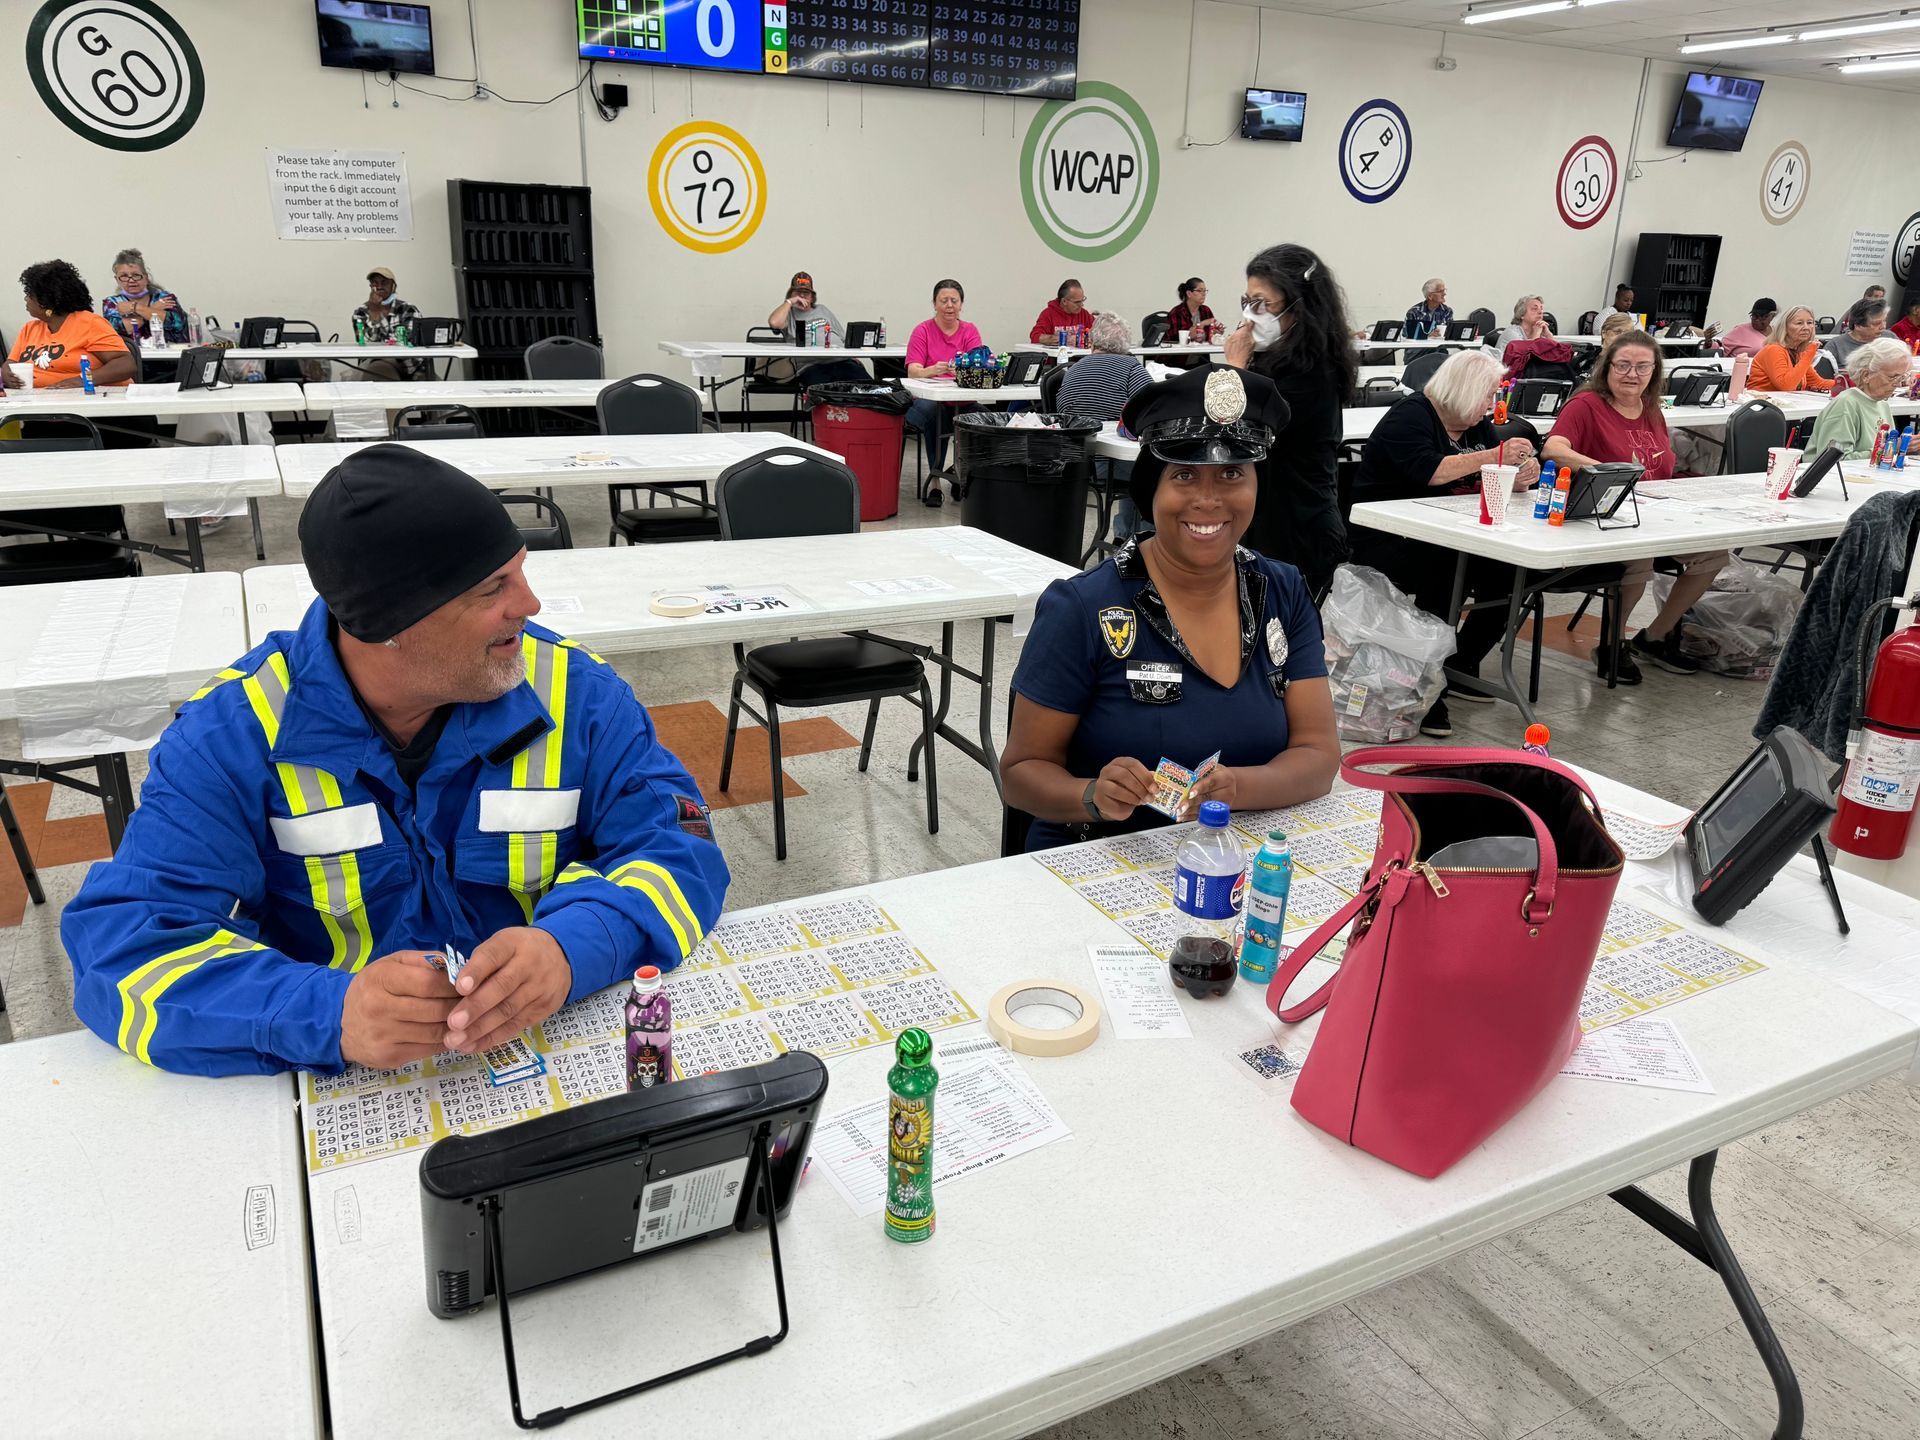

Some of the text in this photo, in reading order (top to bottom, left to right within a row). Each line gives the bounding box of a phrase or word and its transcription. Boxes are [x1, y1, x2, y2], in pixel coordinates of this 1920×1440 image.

[1064, 1, 1077, 13] 15
[872, 1, 887, 12] 20
[892, 3, 907, 14] 21
[912, 5, 926, 16] 22
[935, 7, 949, 19] 23
[954, 9, 968, 21] 24
[973, 11, 987, 23] 25
[992, 13, 1005, 25] 26
[1009, 15, 1023, 27] 27
[1028, 17, 1041, 29] 28
[1046, 19, 1058, 31] 29
[1063, 21, 1076, 33] 30
[696, 0, 735, 57] 0
[772, 10, 1075, 54] N 31 32 33 34 35 36 37 38 39 40 41 42 43 44 45
[77, 25, 112, 56] G
[772, 32, 781, 45] G
[790, 34, 805, 47] 46
[811, 37, 826, 49] 47
[831, 39, 847, 50] 48
[852, 41, 867, 53] 49
[912, 47, 926, 59] 52
[934, 49, 948, 61] 53
[953, 51, 966, 63] 54
[972, 53, 985, 65] 55
[990, 55, 1004, 67] 56
[1008, 56, 1022, 68] 57
[1026, 58, 1039, 70] 58
[1044, 60, 1057, 71] 59
[772, 55, 1073, 93] O 63 64 65 66 67 68 69 70 71 72 75
[91, 50, 166, 117] 60
[1378, 126, 1394, 148] B
[277, 155, 396, 169] Please take any computer
[1360, 150, 1379, 174] 4
[1583, 156, 1588, 173] I
[1785, 158, 1796, 174] N
[276, 169, 400, 182] from the rack. Immediately
[1050, 148, 1134, 194] WCAP
[284, 183, 396, 195] input the 6 digit account
[1574, 174, 1601, 210] 30
[1771, 177, 1794, 207] 41
[285, 197, 399, 208] number at the bottom of
[683, 177, 741, 224] 72
[289, 211, 399, 221] your tally. Any problems
[294, 224, 324, 234] please
[327, 225, 342, 233] ask
[352, 225, 397, 234] volunteer.
[705, 601, 789, 614] WCAP
[1141, 664, 1169, 672] OFFICER
[933, 1010, 947, 1018] 26
[883, 1022, 898, 1030] 73
[317, 1087, 423, 1116] 14 27 34 59 72
[386, 1101, 403, 1110] 28
[892, 1095, 926, 1114] BINGO
[340, 1111, 357, 1121] 55
[363, 1107, 380, 1116] 44
[317, 1117, 334, 1126] 70
[318, 1106, 422, 1136] 5 29 50 74
[389, 1120, 406, 1129] 22
[341, 1131, 359, 1141] 54
[365, 1126, 383, 1135] 40
[318, 1125, 429, 1157] 13 26 35 51 68
[318, 1137, 336, 1146] 62
[932, 1152, 1006, 1184] WCAP Bingo Program
